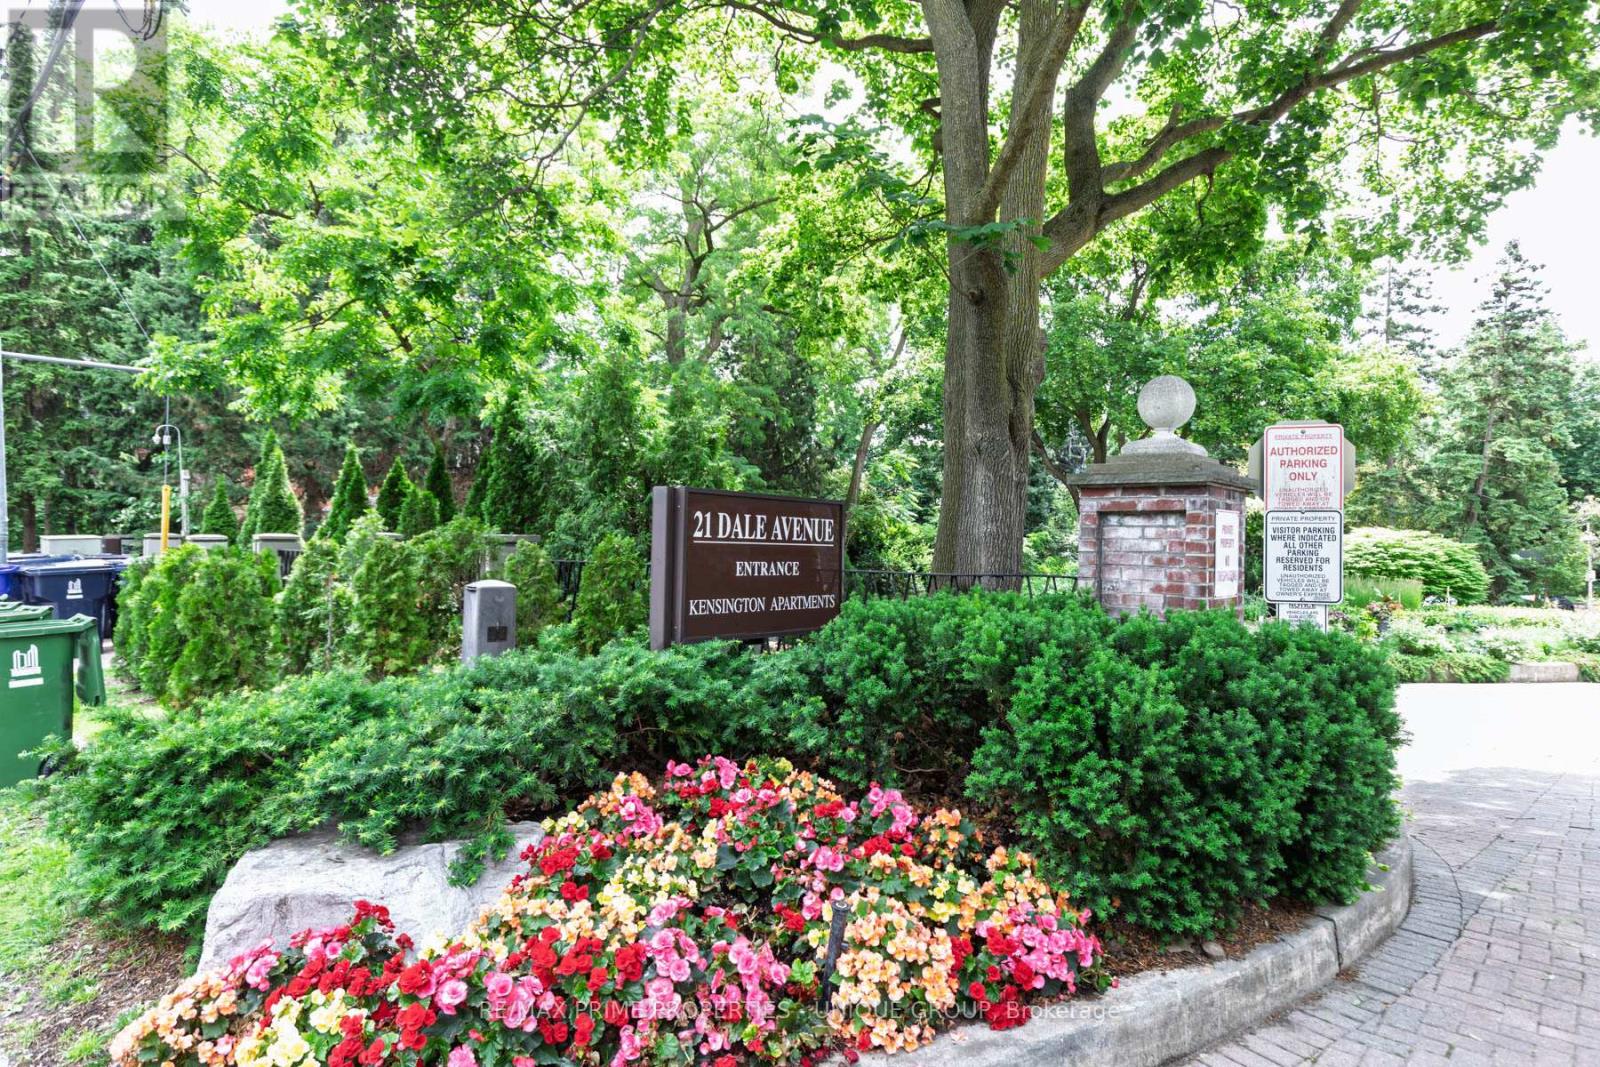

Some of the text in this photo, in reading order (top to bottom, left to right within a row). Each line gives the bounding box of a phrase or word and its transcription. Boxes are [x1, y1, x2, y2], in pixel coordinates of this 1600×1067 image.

[1270, 445, 1338, 456] AUTHORIZED
[1279, 458, 1328, 469] PARKING
[1289, 471, 1318, 481] ONLY
[693, 511, 835, 542] 21 DALE AVENUE
[1272, 526, 1336, 534] VISITOR PARKING
[1276, 556, 1314, 564] RESERVED
[735, 561, 800, 576] ENTRANCE
[689, 594, 835, 615] KENSINGTON APARTMENTS
